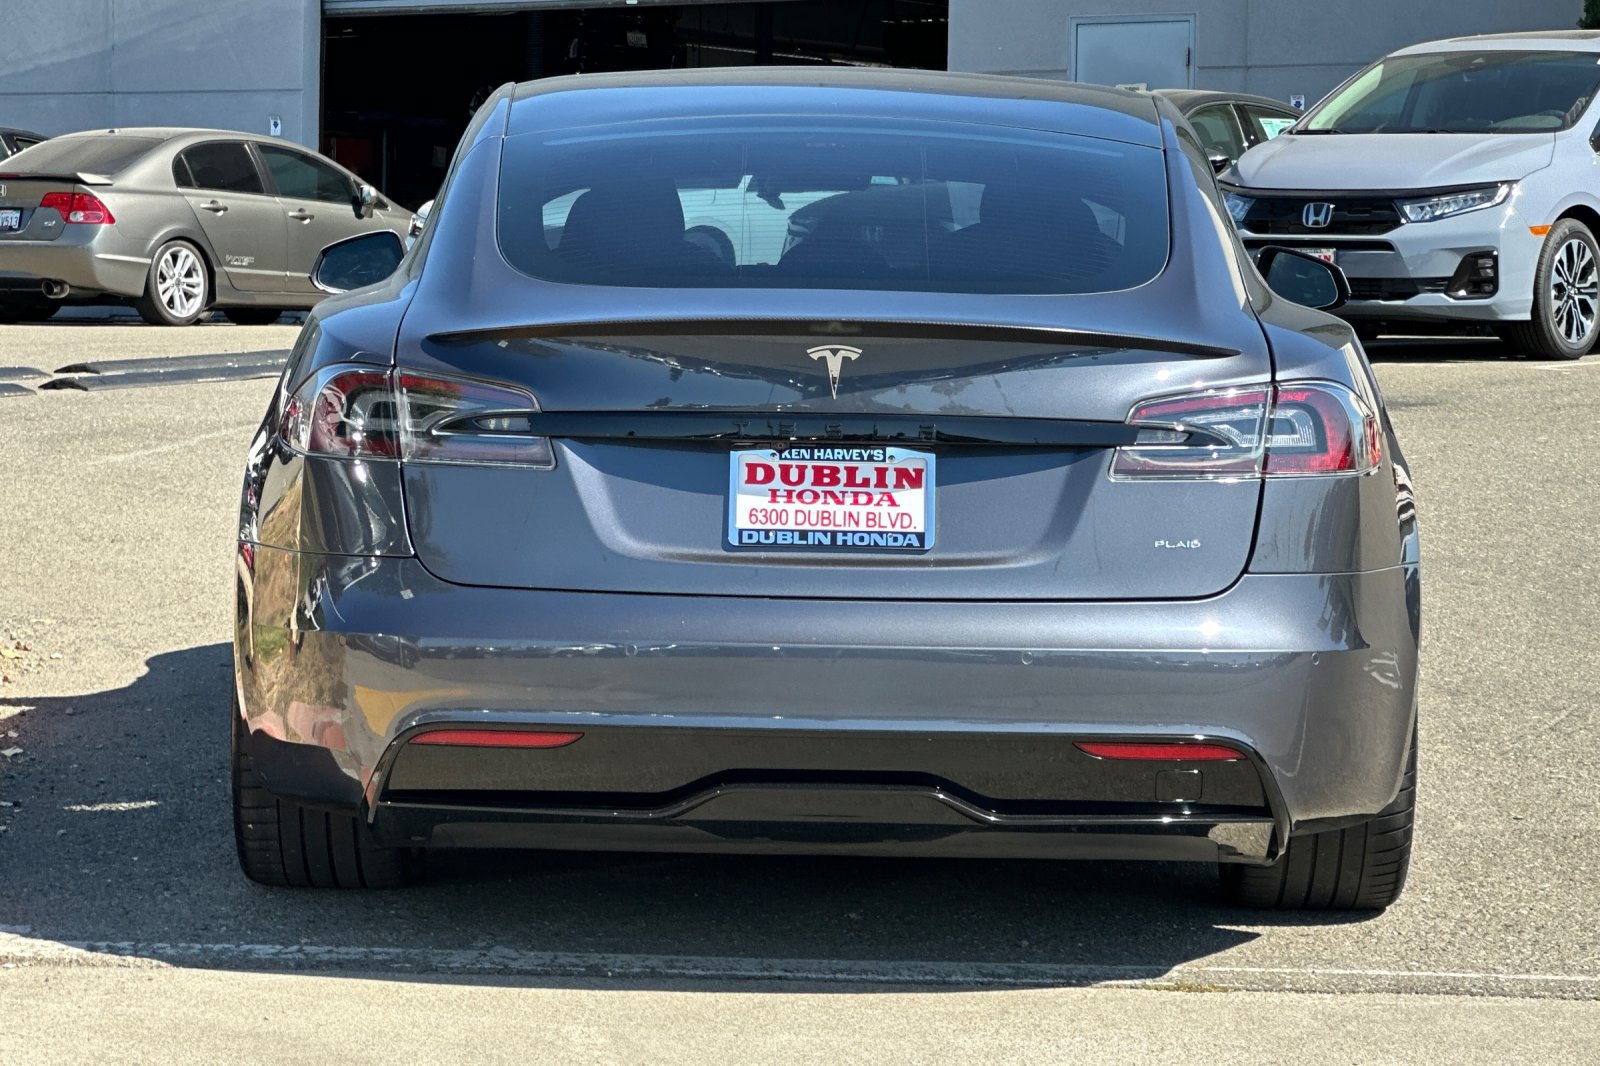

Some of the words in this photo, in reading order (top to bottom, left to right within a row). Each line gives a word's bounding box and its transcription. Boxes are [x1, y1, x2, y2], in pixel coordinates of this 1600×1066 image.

[781, 448, 811, 460] KEN
[813, 448, 884, 461] HARVEY'S
[744, 462, 925, 489] DUBLIN
[768, 488, 900, 507] HONDA
[748, 507, 789, 526] 6300
[794, 509, 861, 528] DUBLIN
[865, 511, 917, 530] BLVD.
[741, 530, 831, 545] DUBLIN
[836, 531, 921, 547] HONDA
